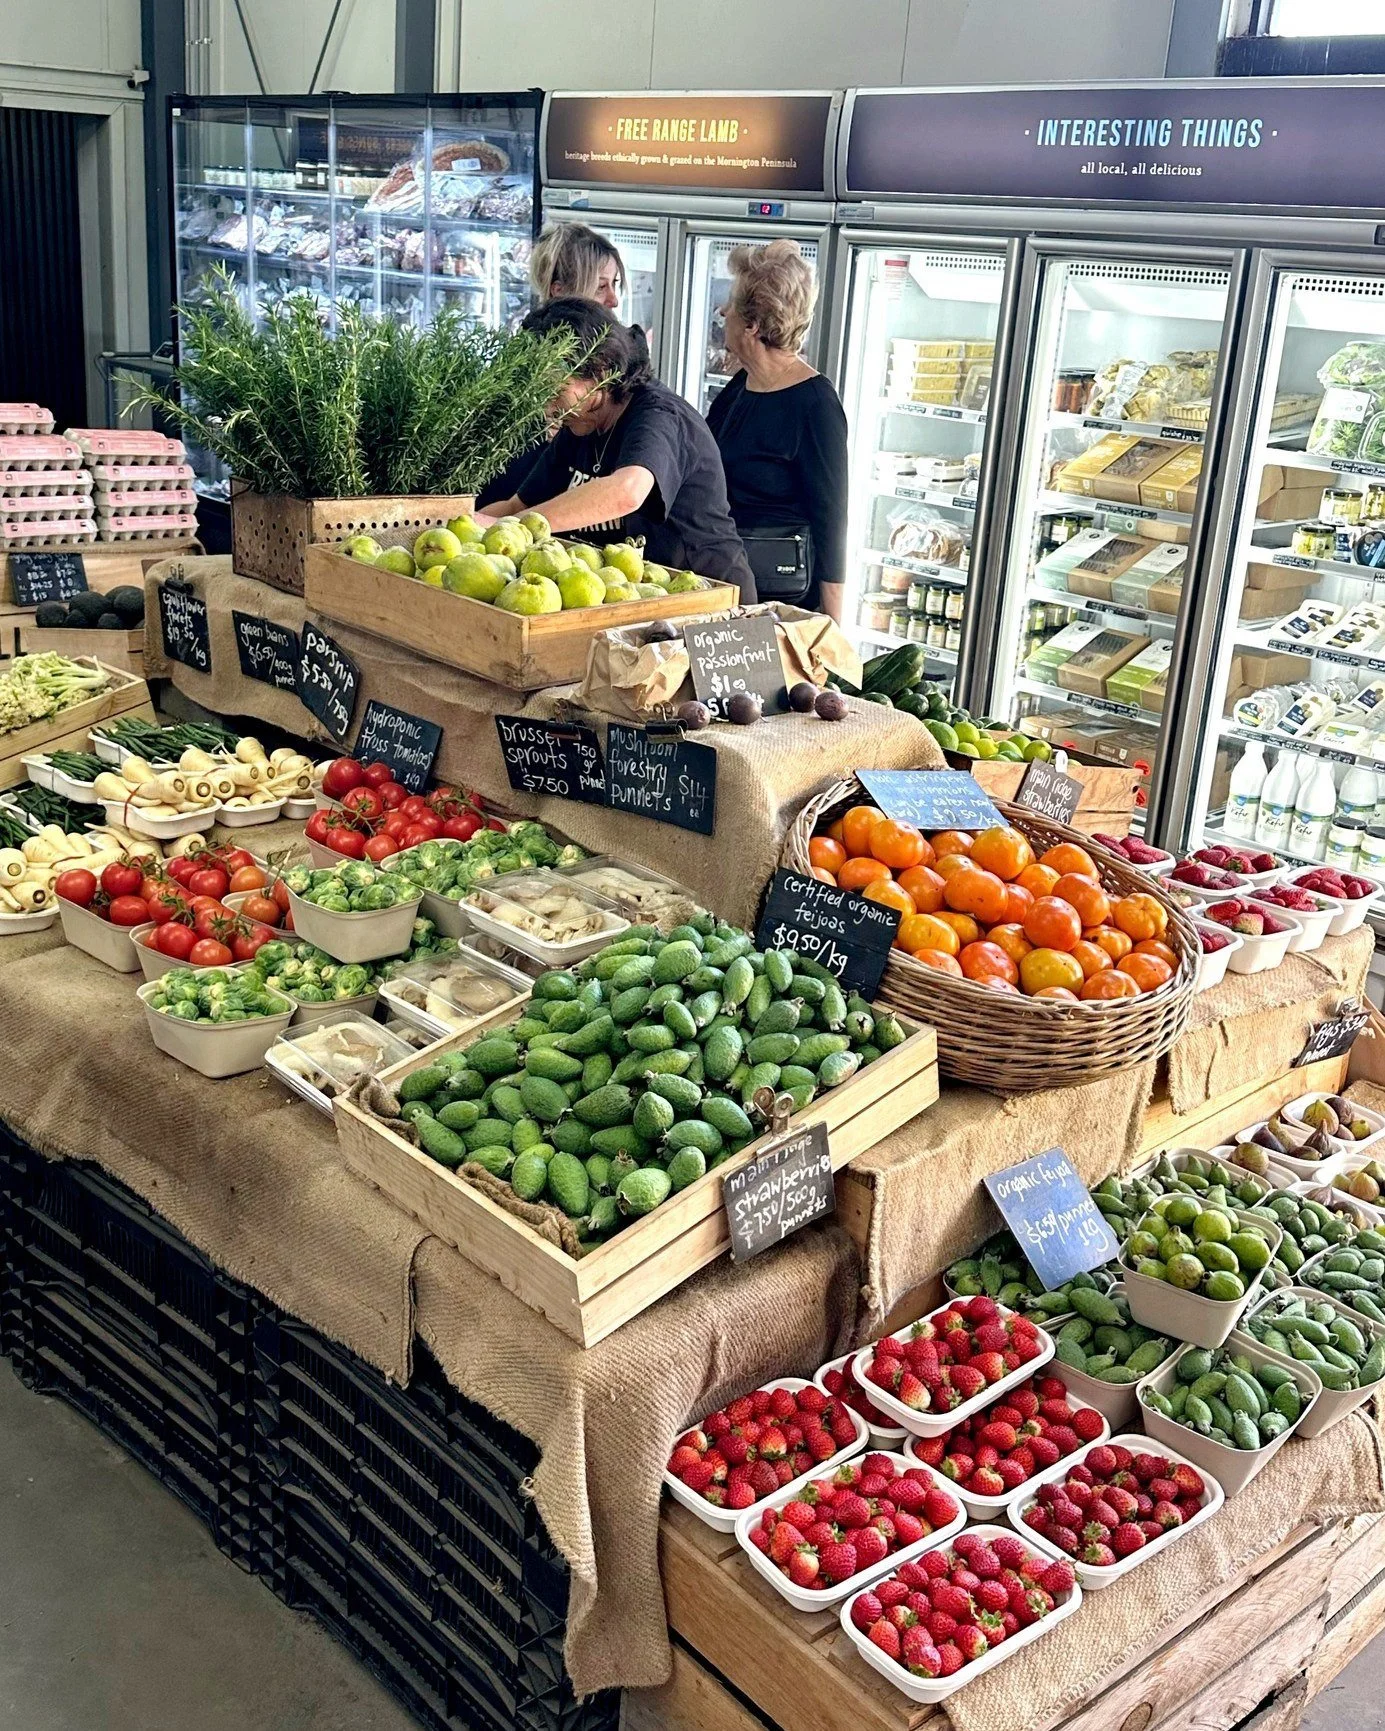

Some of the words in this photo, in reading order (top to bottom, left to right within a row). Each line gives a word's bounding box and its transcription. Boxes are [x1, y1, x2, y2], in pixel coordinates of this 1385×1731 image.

[616, 118, 649, 141] FREE
[652, 119, 696, 142] RANGE
[700, 120, 739, 143] LAMB
[1037, 119, 1173, 147] INTERESTING
[1181, 118, 1263, 148] THINGS
[565, 150, 590, 162] heritage
[591, 151, 611, 161] breeds
[612, 152, 640, 164] ethically
[640, 155, 661, 165] grown
[662, 154, 669, 163] &
[670, 154, 692, 166] grazed
[693, 157, 703, 165] on
[704, 155, 716, 165] the
[717, 155, 760, 169] Mornington
[761, 157, 797, 168] Peninsula
[1081, 162, 1095, 174] all
[1098, 162, 1128, 175] local,
[1131, 163, 1146, 175] all
[1149, 163, 1202, 176] delicious
[162, 592, 206, 616] cauliflower
[166, 604, 194, 628] florets
[240, 622, 263, 647] green
[265, 623, 289, 647] beans
[693, 624, 744, 657] organic
[305, 632, 354, 692] parsnip
[696, 641, 776, 677] passionfruit
[710, 672, 730, 698] $1
[732, 678, 746, 690] ea
[366, 702, 422, 740] hydroponic
[361, 726, 389, 753] truss
[393, 735, 434, 770] tomatoes
[506, 744, 568, 772] sprouts
[573, 742, 597, 758] 750
[582, 759, 597, 774] gr
[609, 748, 668, 792] forestry
[904, 774, 969, 787] astringent
[611, 783, 672, 811] punnets
[678, 764, 709, 811] $14
[1029, 768, 1051, 790] main
[1051, 777, 1073, 806] ridge
[689, 808, 700, 818] ea
[914, 797, 928, 808] be
[933, 797, 968, 808] eaten
[1022, 785, 1072, 825] strawberries
[794, 901, 846, 935] feijoas
[848, 899, 897, 926] organic
[1313, 1022, 1342, 1049] figs
[730, 1159, 769, 1193] main
[997, 1171, 1041, 1203] organic
[780, 1195, 828, 1239] punnets
